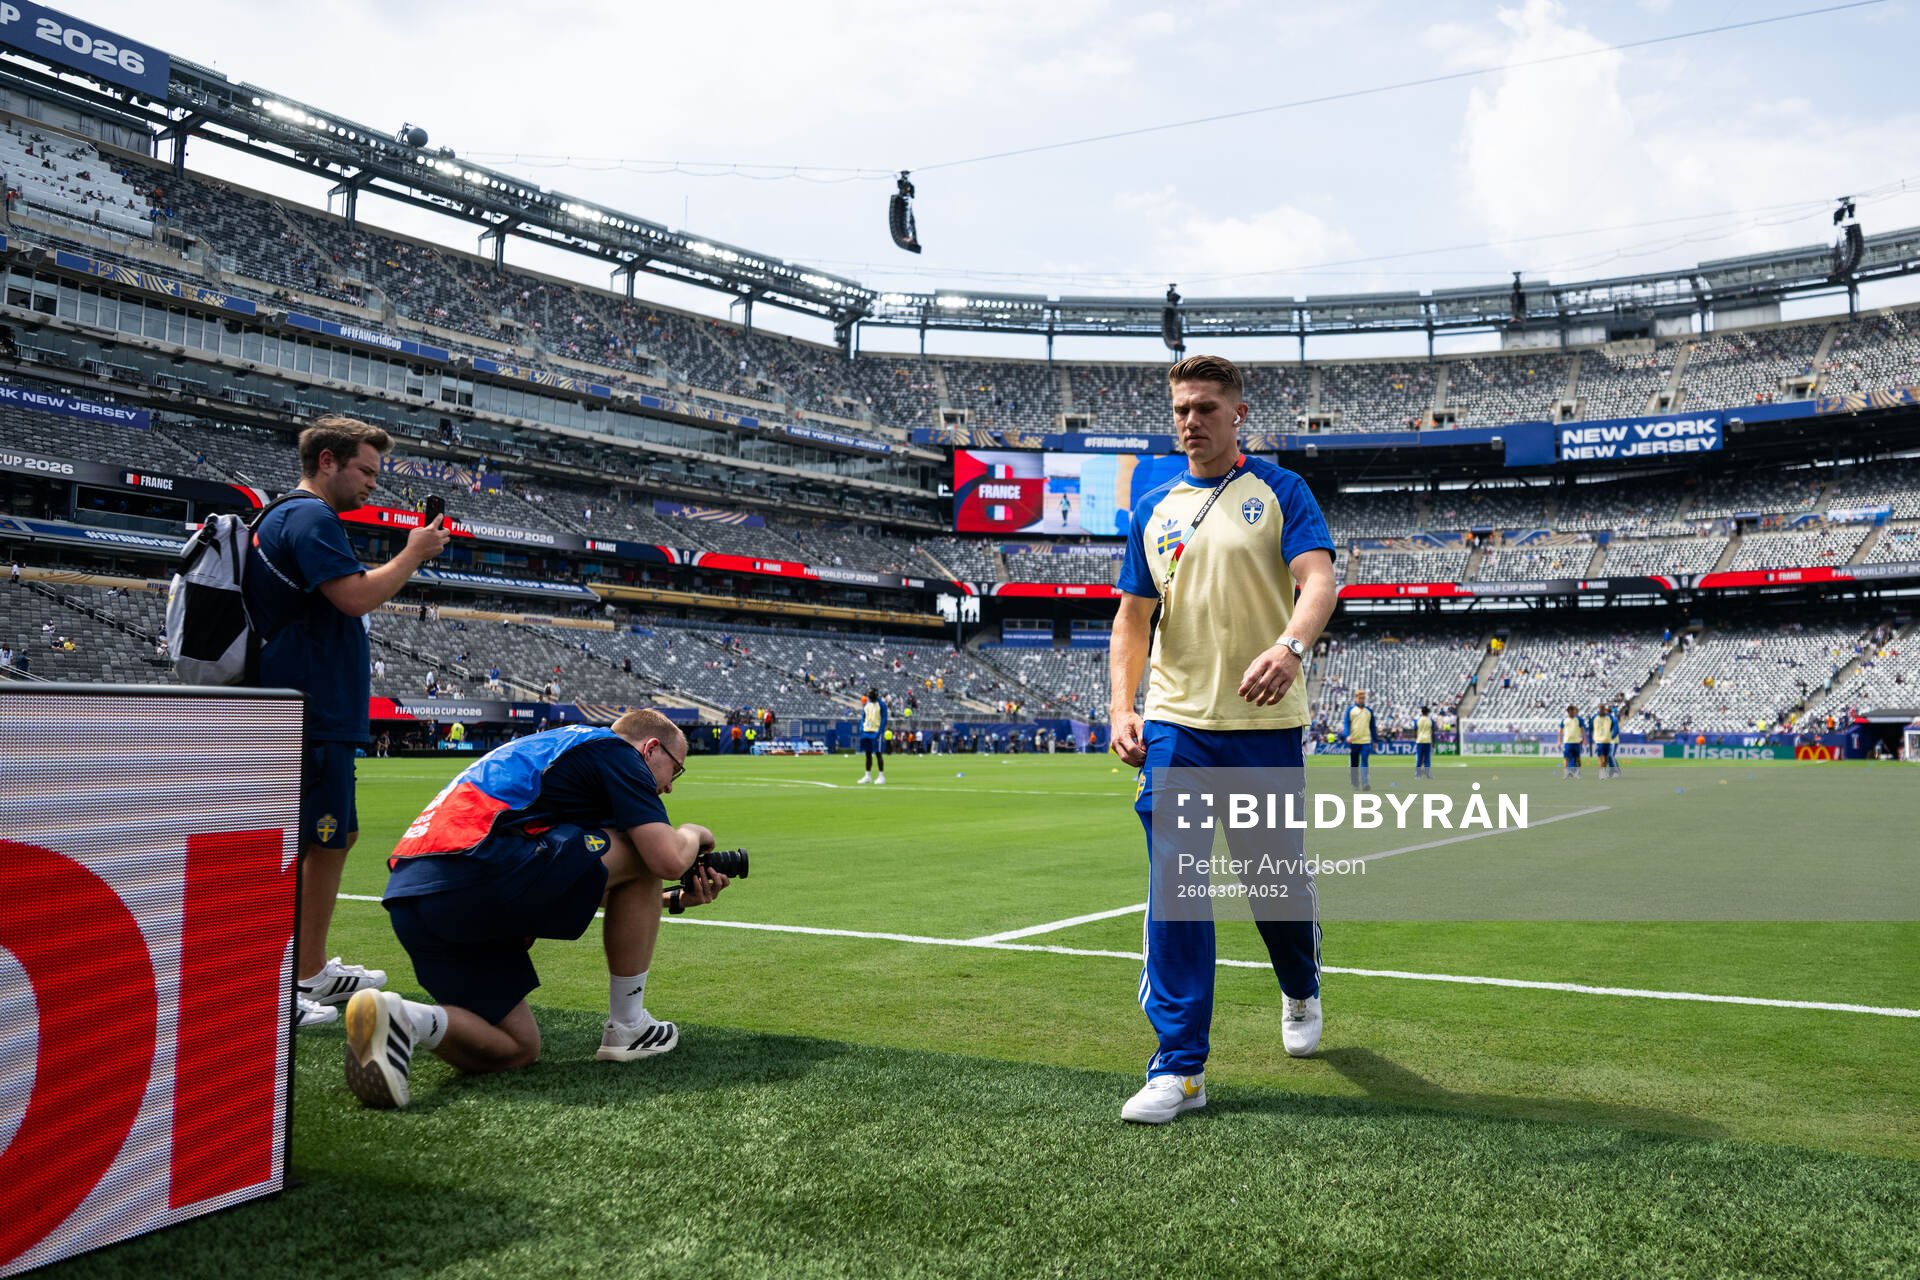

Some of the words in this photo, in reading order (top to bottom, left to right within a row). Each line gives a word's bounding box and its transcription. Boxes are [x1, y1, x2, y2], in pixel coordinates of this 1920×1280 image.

[35, 18, 145, 74] 2026
[340, 326, 402, 351] #FIFAWorldCup
[22, 392, 65, 407] NEW
[68, 402, 137, 420] JERSEY
[1562, 426, 1628, 445] NEW
[1634, 418, 1717, 439] YORK
[1562, 444, 1617, 460] NEW
[1621, 437, 1717, 456] JERSEY
[25, 458, 74, 474] 2026
[141, 475, 173, 490] FRANCE
[979, 484, 1021, 500] FRANCE
[393, 514, 419, 526] FRANCE
[451, 522, 472, 533] FIFA
[473, 525, 504, 538] WORLD
[505, 529, 524, 540] CUP
[524, 532, 555, 544] 2026
[595, 541, 617, 553] FRANCE
[803, 567, 818, 577] FIFA
[819, 569, 842, 579] WORLD
[842, 572, 856, 581] CUP
[856, 573, 879, 583] 2026
[1832, 569, 1852, 578] FIFA
[1853, 568, 1887, 577] WORLD
[1888, 567, 1906, 575] CUP
[395, 706, 412, 715] FIFA
[413, 707, 440, 716] WORLD
[441, 707, 456, 716] CUP
[456, 707, 482, 716] 2026
[516, 709, 534, 718] FRANCE
[1682, 744, 1774, 761] Hisense
